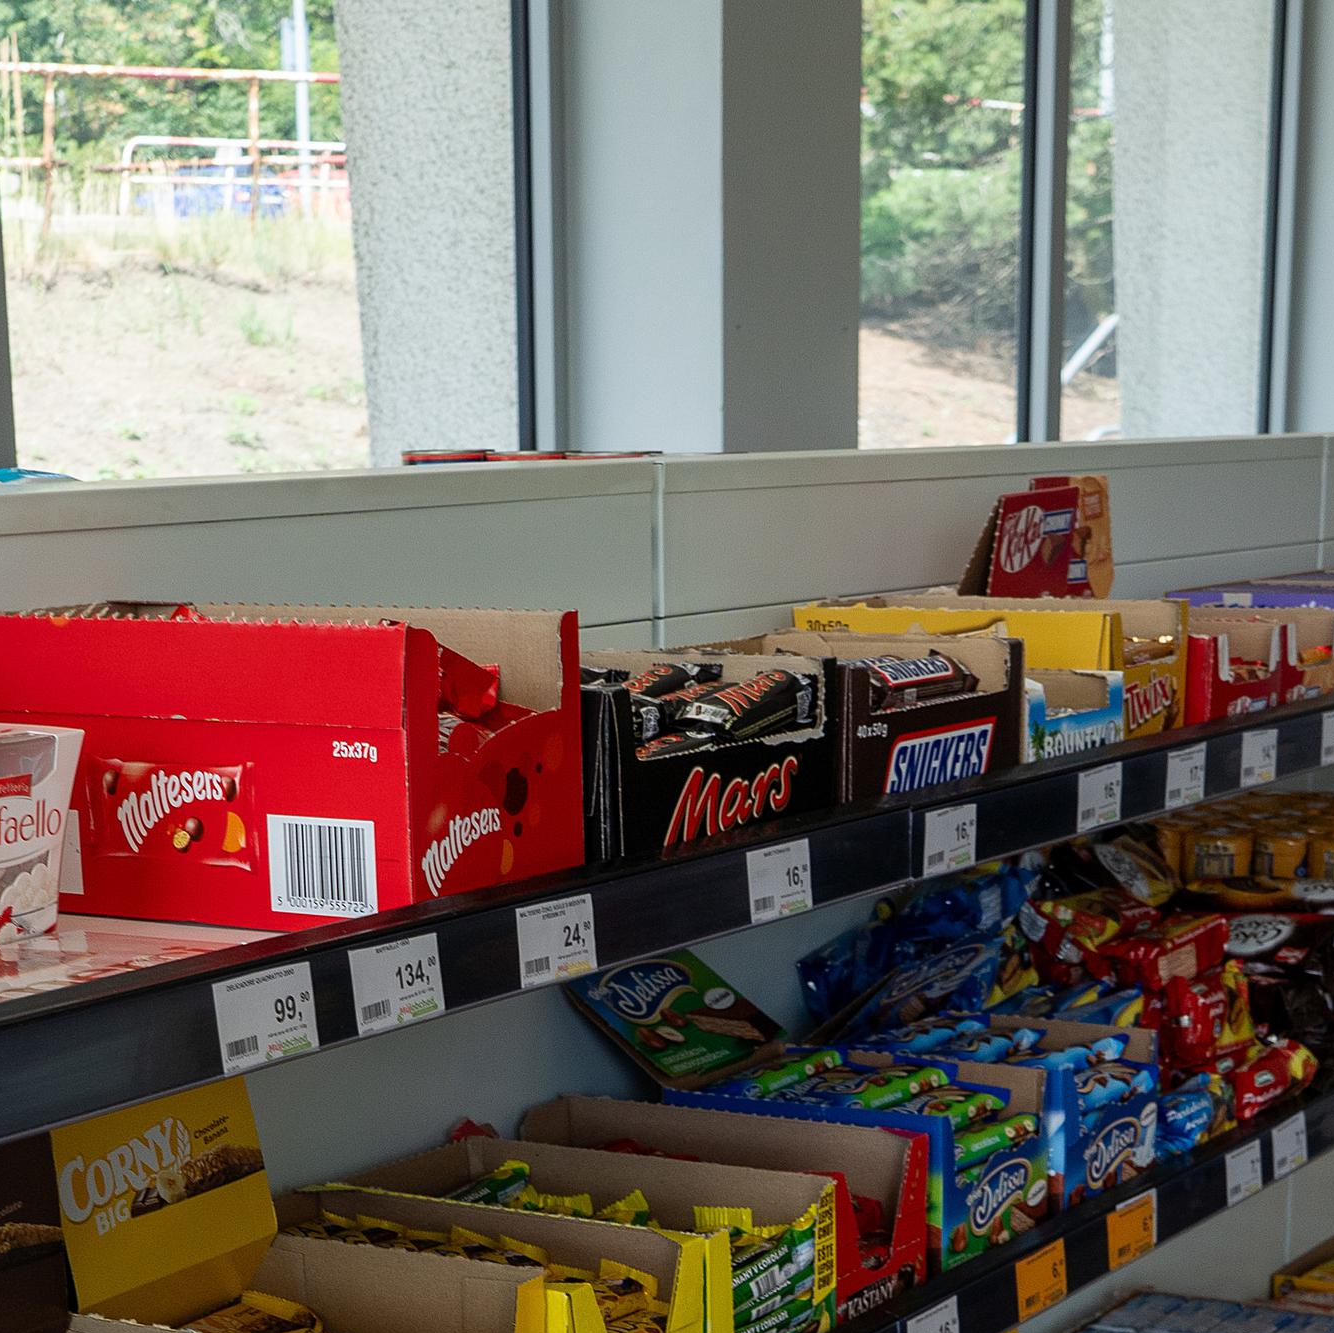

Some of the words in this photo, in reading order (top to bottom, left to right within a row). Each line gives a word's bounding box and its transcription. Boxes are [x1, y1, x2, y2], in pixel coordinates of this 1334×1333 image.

[622, 665, 673, 694] ars
[876, 654, 954, 683] SNICKERS
[715, 670, 787, 717] Mars
[1123, 673, 1170, 729] Twix
[331, 740, 379, 764] 25x37g
[889, 722, 996, 794] SNICKERS
[1043, 728, 1104, 758] BOUNTY
[117, 769, 224, 854] Maltesers
[664, 755, 799, 847] Mars
[421, 806, 502, 898] Maltesers
[786, 867, 804, 889] 16,
[276, 896, 285, 908] 5
[289, 897, 326, 912] 000159
[328, 899, 367, 915] 555722
[563, 922, 586, 948] 24,
[396, 959, 431, 990] 134,
[607, 965, 684, 1016] Delissa
[274, 995, 303, 1024] 99,
[202, 1126, 230, 1146] Banana
[58, 1117, 175, 1224] CORNY
[974, 1167, 1027, 1226] Delissa
[95, 1197, 133, 1237] BIG
